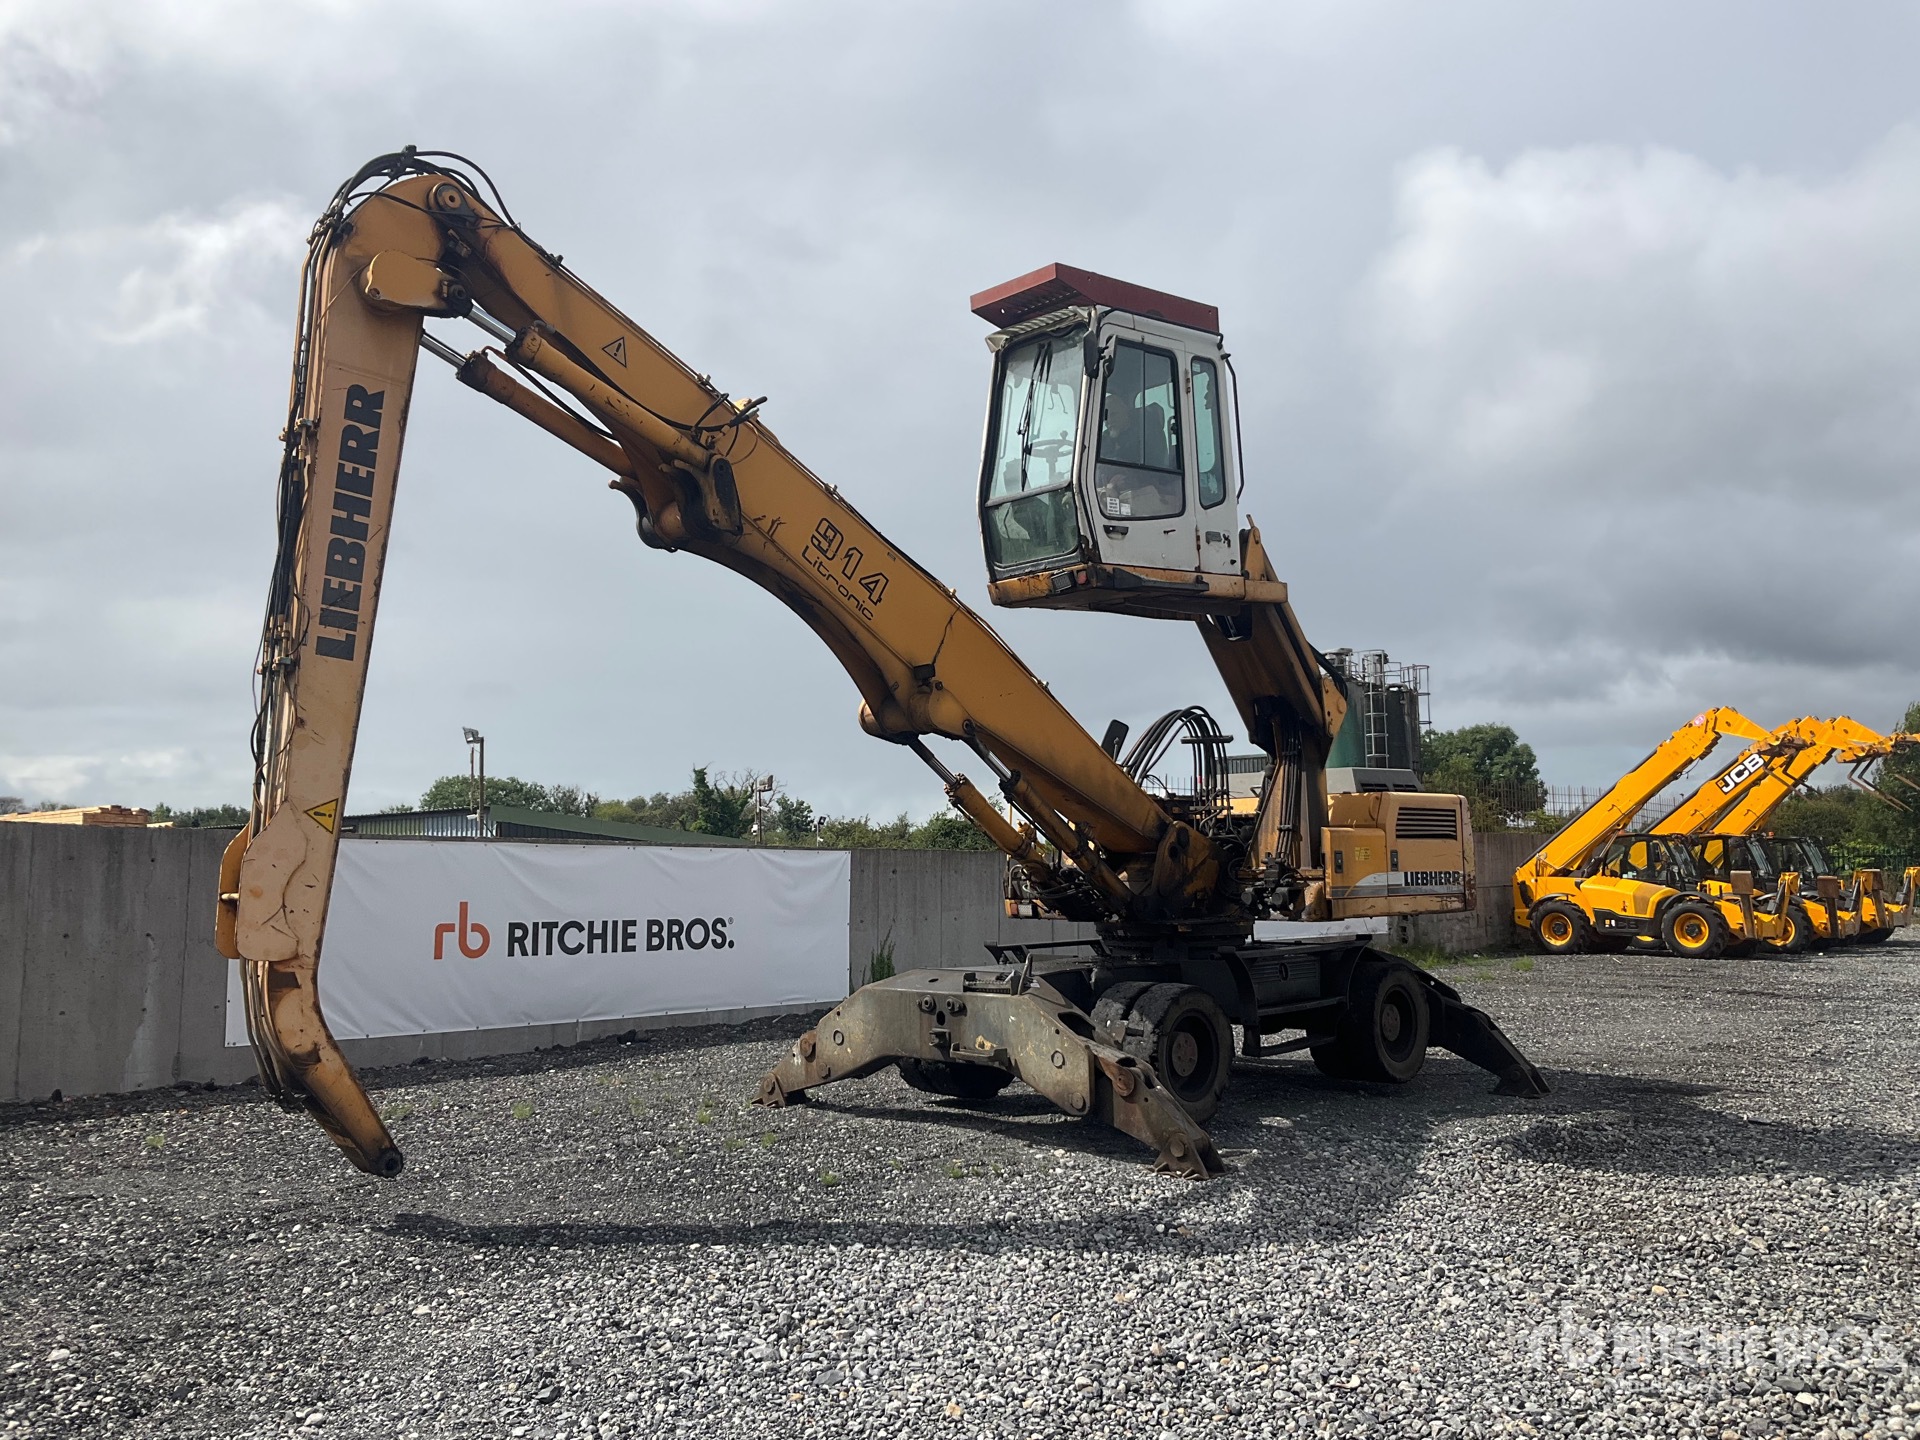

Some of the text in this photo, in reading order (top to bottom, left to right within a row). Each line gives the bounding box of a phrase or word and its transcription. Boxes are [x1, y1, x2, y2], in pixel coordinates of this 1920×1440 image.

[315, 384, 385, 661] LIEBHERR
[802, 546, 874, 621] Litronic
[811, 518, 889, 606] 914
[1721, 754, 1765, 793] JCB
[1404, 871, 1461, 886] LIEBHERR
[434, 901, 490, 960] rb
[507, 919, 637, 957] RITCHIE
